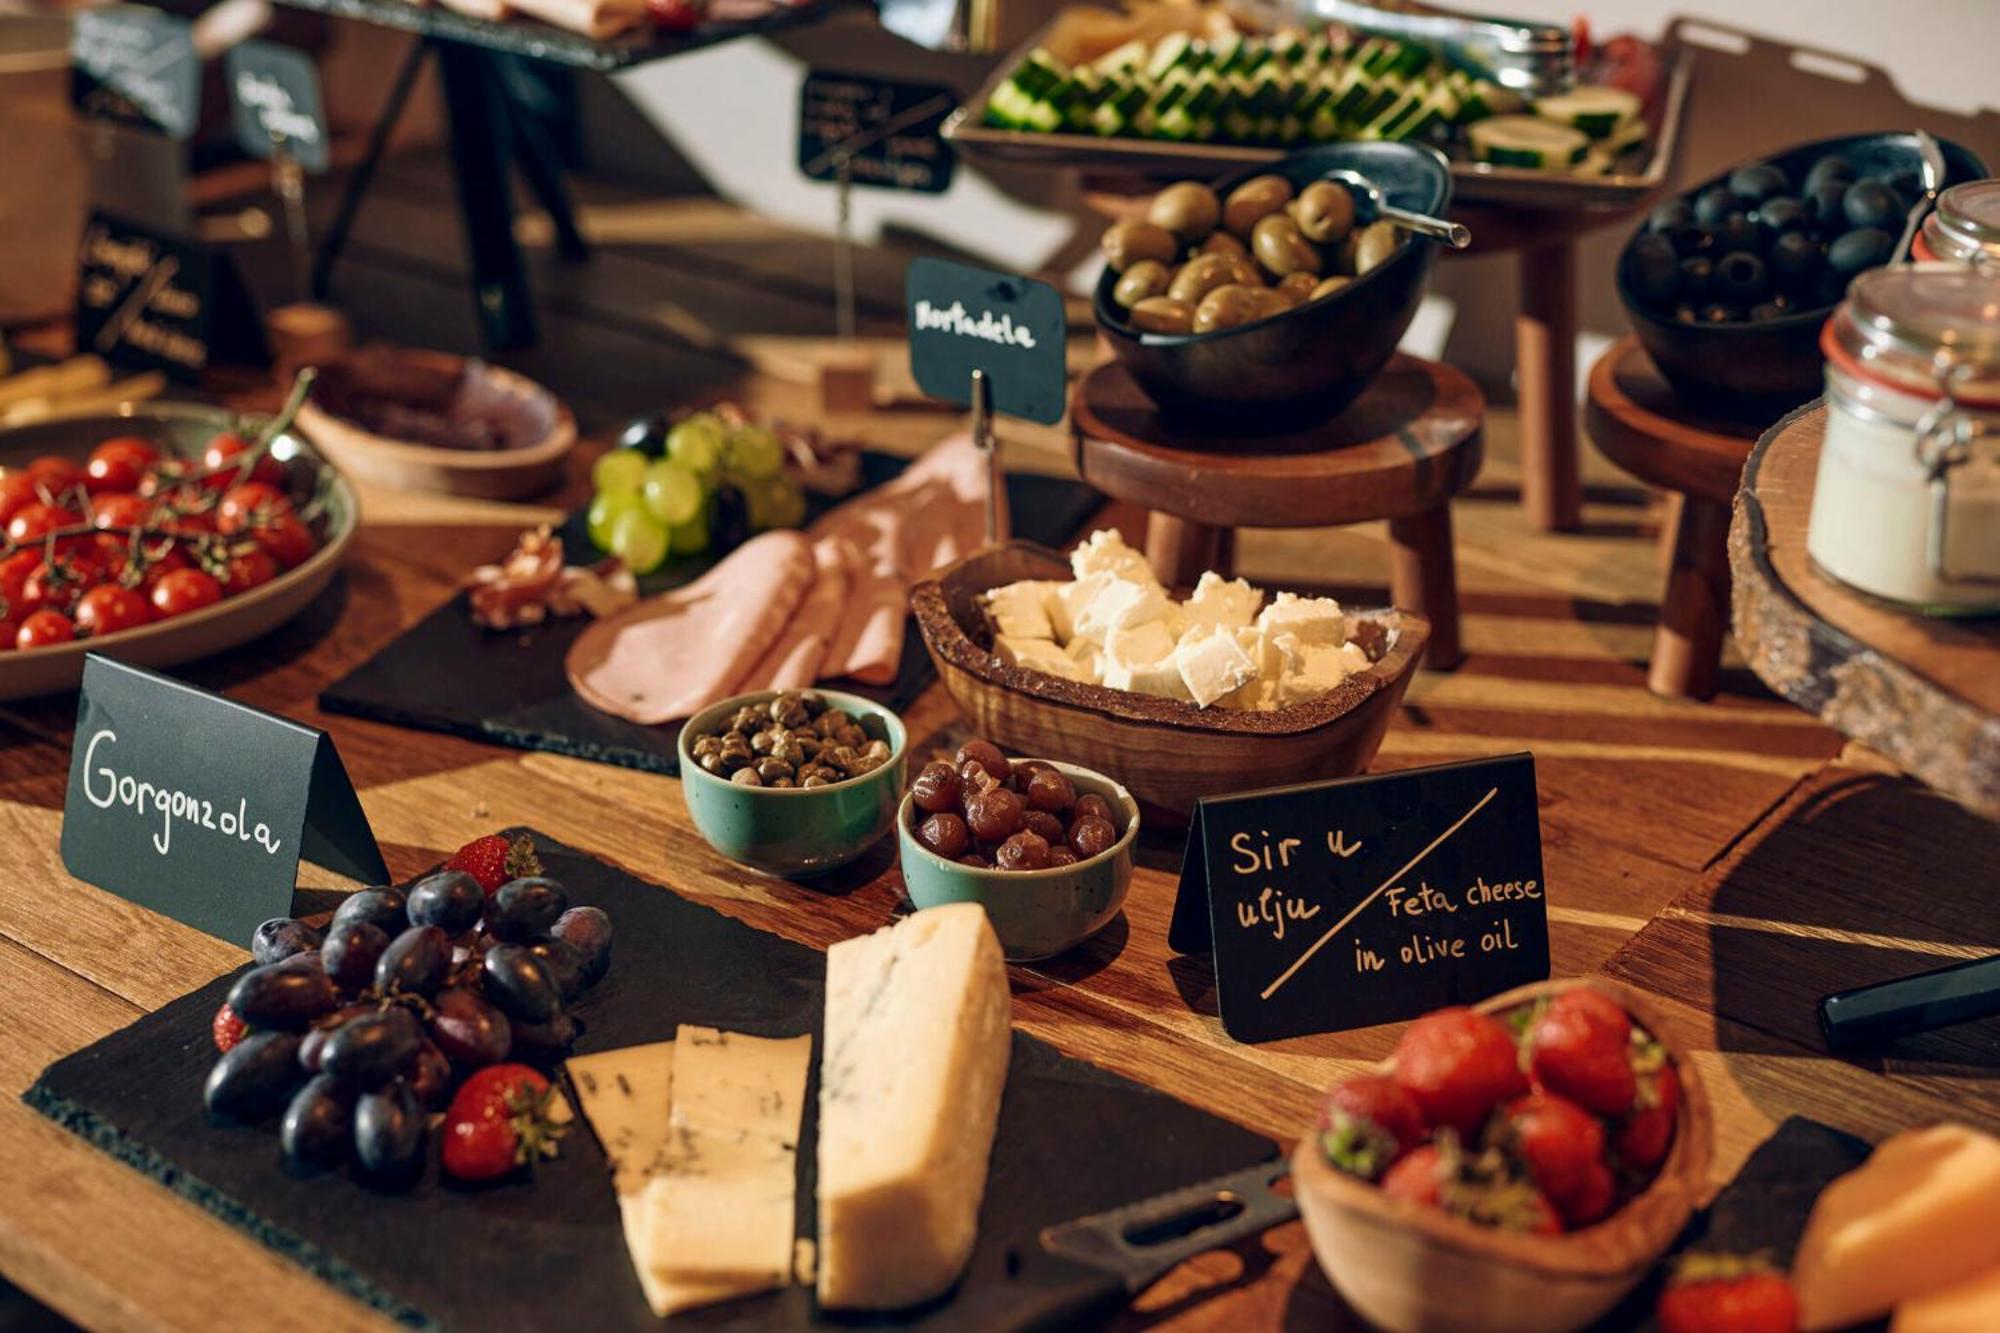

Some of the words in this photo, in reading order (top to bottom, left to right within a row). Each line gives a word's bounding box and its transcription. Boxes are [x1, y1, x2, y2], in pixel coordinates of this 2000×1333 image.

[83, 729, 281, 855] Gorgonzola
[1231, 830, 1301, 874] Sir
[1327, 830, 1363, 857] u
[1238, 887, 1320, 939] ulju
[1386, 882, 1458, 917] Feta
[1466, 877, 1542, 906] cheese
[1355, 939, 1386, 973] in
[1400, 935, 1466, 964] olive
[1481, 918, 1519, 951] oil
